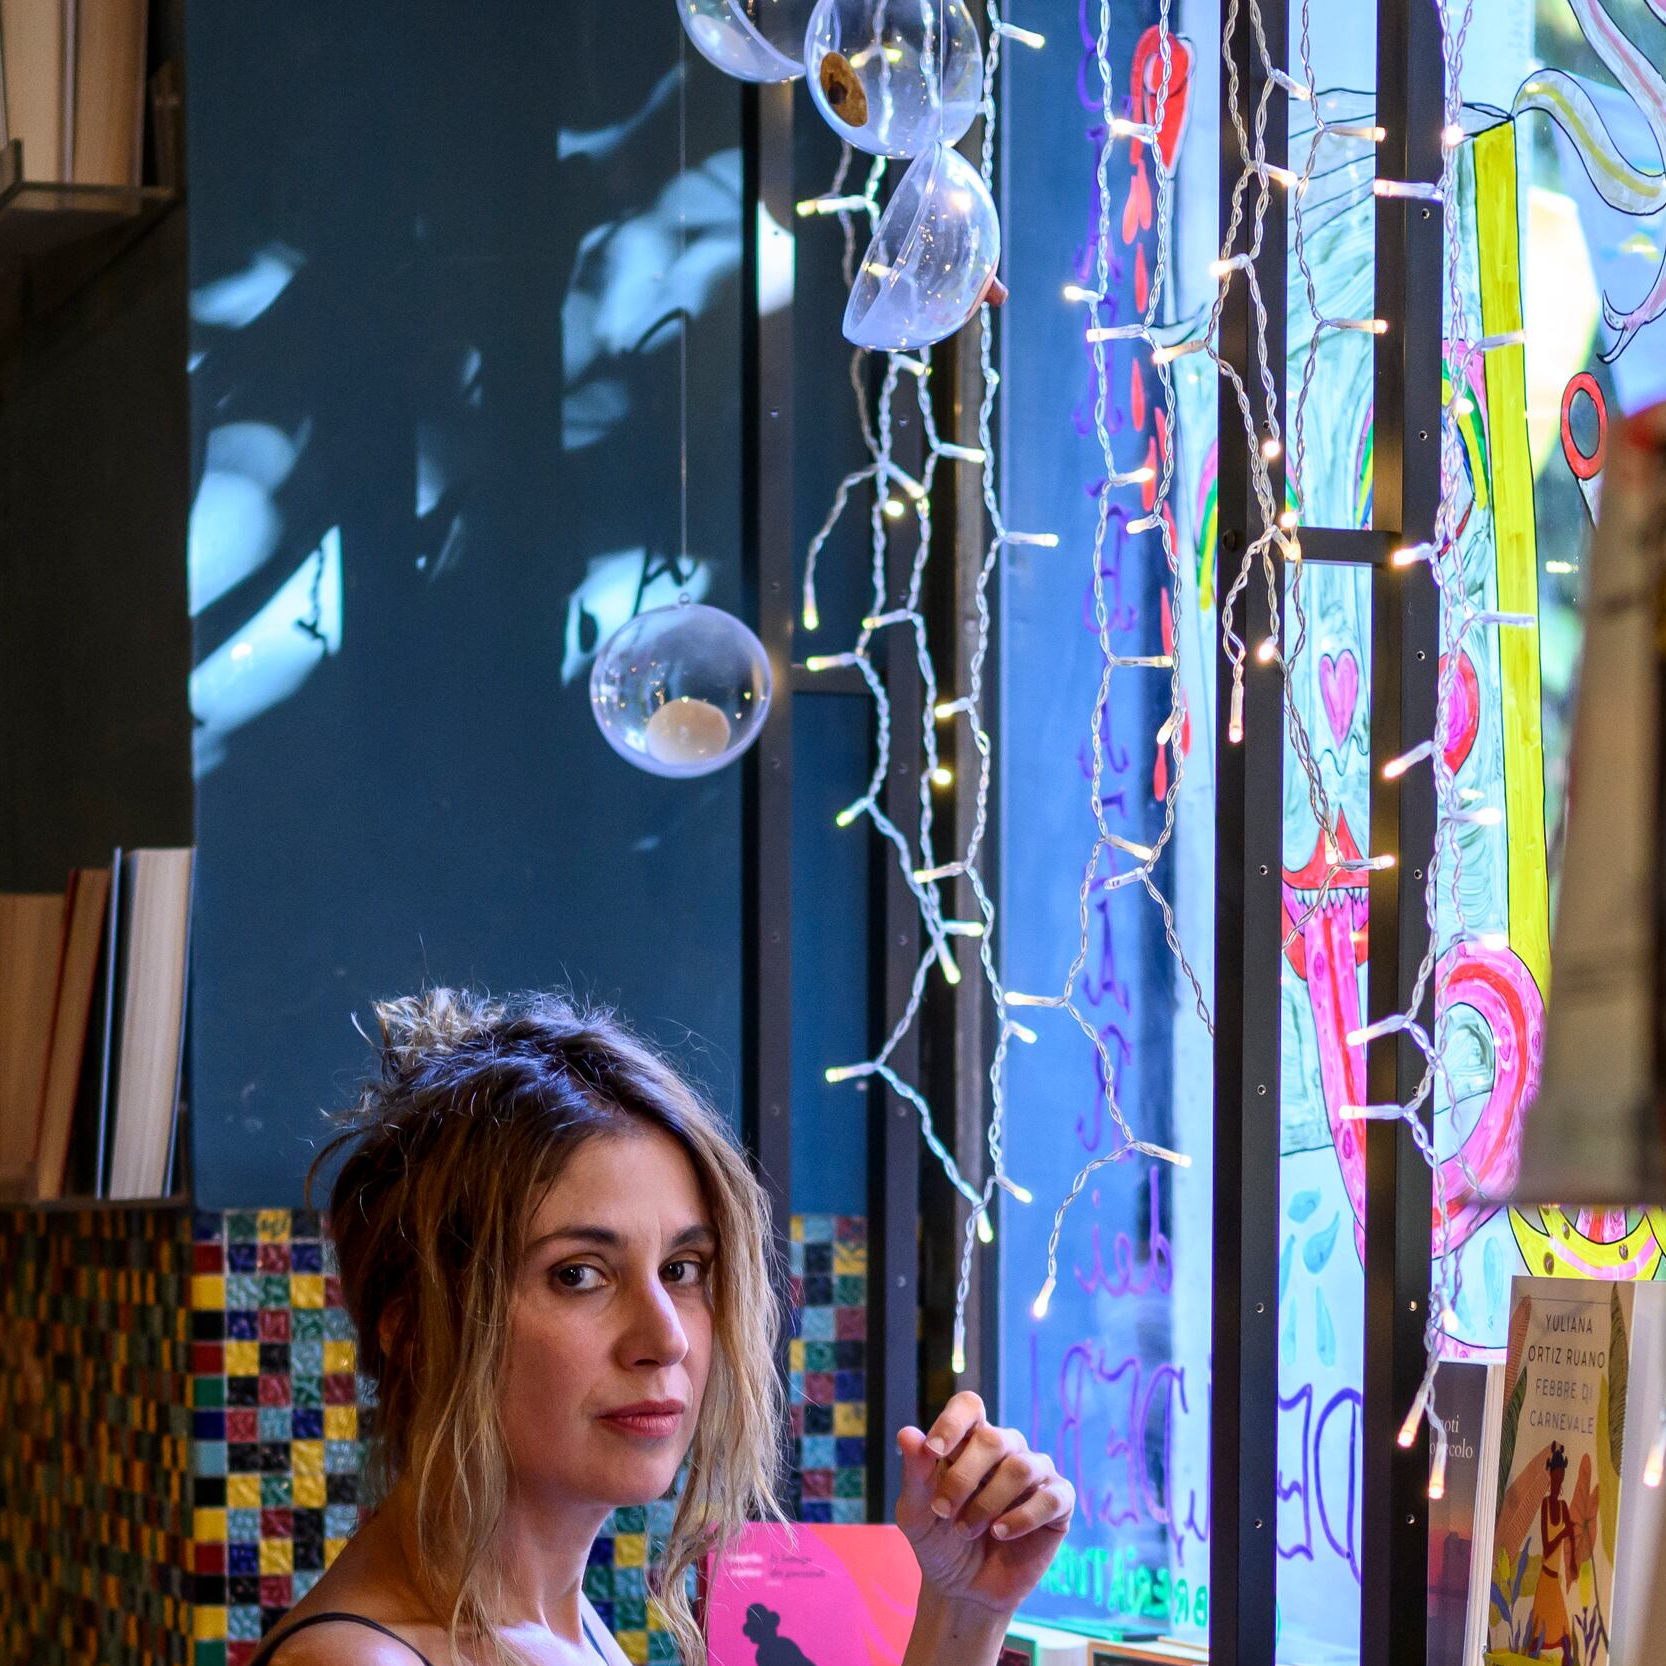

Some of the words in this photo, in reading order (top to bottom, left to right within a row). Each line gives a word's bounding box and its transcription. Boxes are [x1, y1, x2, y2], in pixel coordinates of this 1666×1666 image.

[1545, 1313, 1593, 1335] YULIANA
[1528, 1345, 1562, 1364] ORTIZ
[1566, 1348, 1606, 1369] RUANO
[1536, 1377, 1577, 1400] FEBBRE
[1529, 1410, 1595, 1435] CARNEVALE
